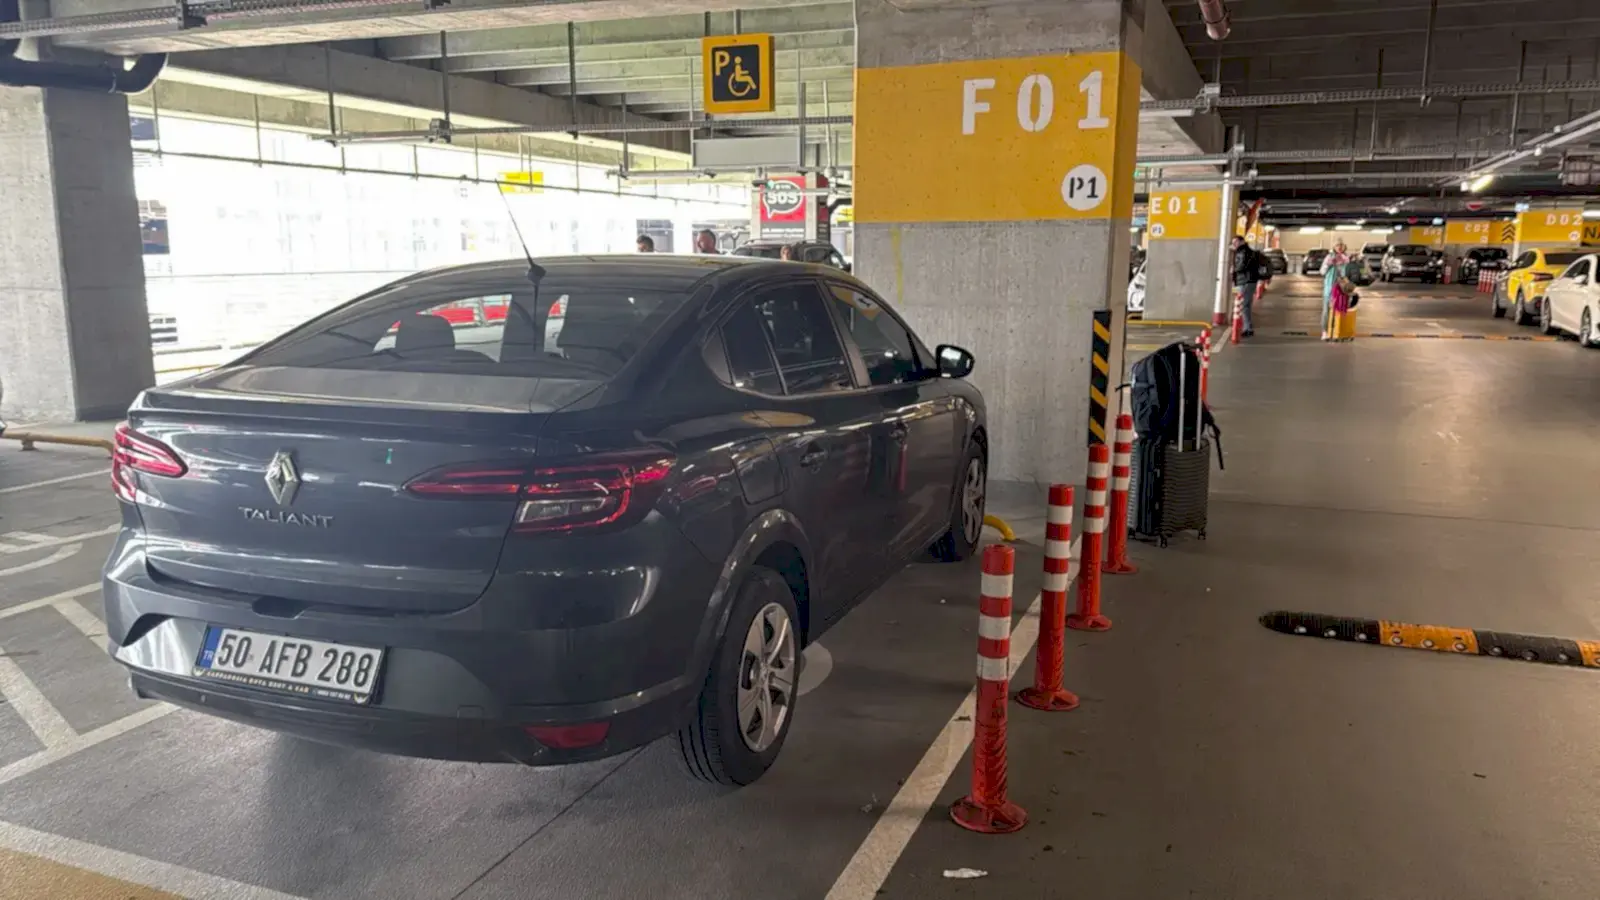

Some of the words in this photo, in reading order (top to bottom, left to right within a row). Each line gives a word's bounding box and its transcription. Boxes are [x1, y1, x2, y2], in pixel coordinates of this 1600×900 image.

[715, 51, 730, 76] P
[767, 191, 798, 204] SOS
[1069, 176, 1099, 199] P1
[238, 506, 334, 529] TALIANT
[217, 633, 253, 669] 50
[258, 640, 313, 678] AFB
[317, 647, 374, 688] 288
